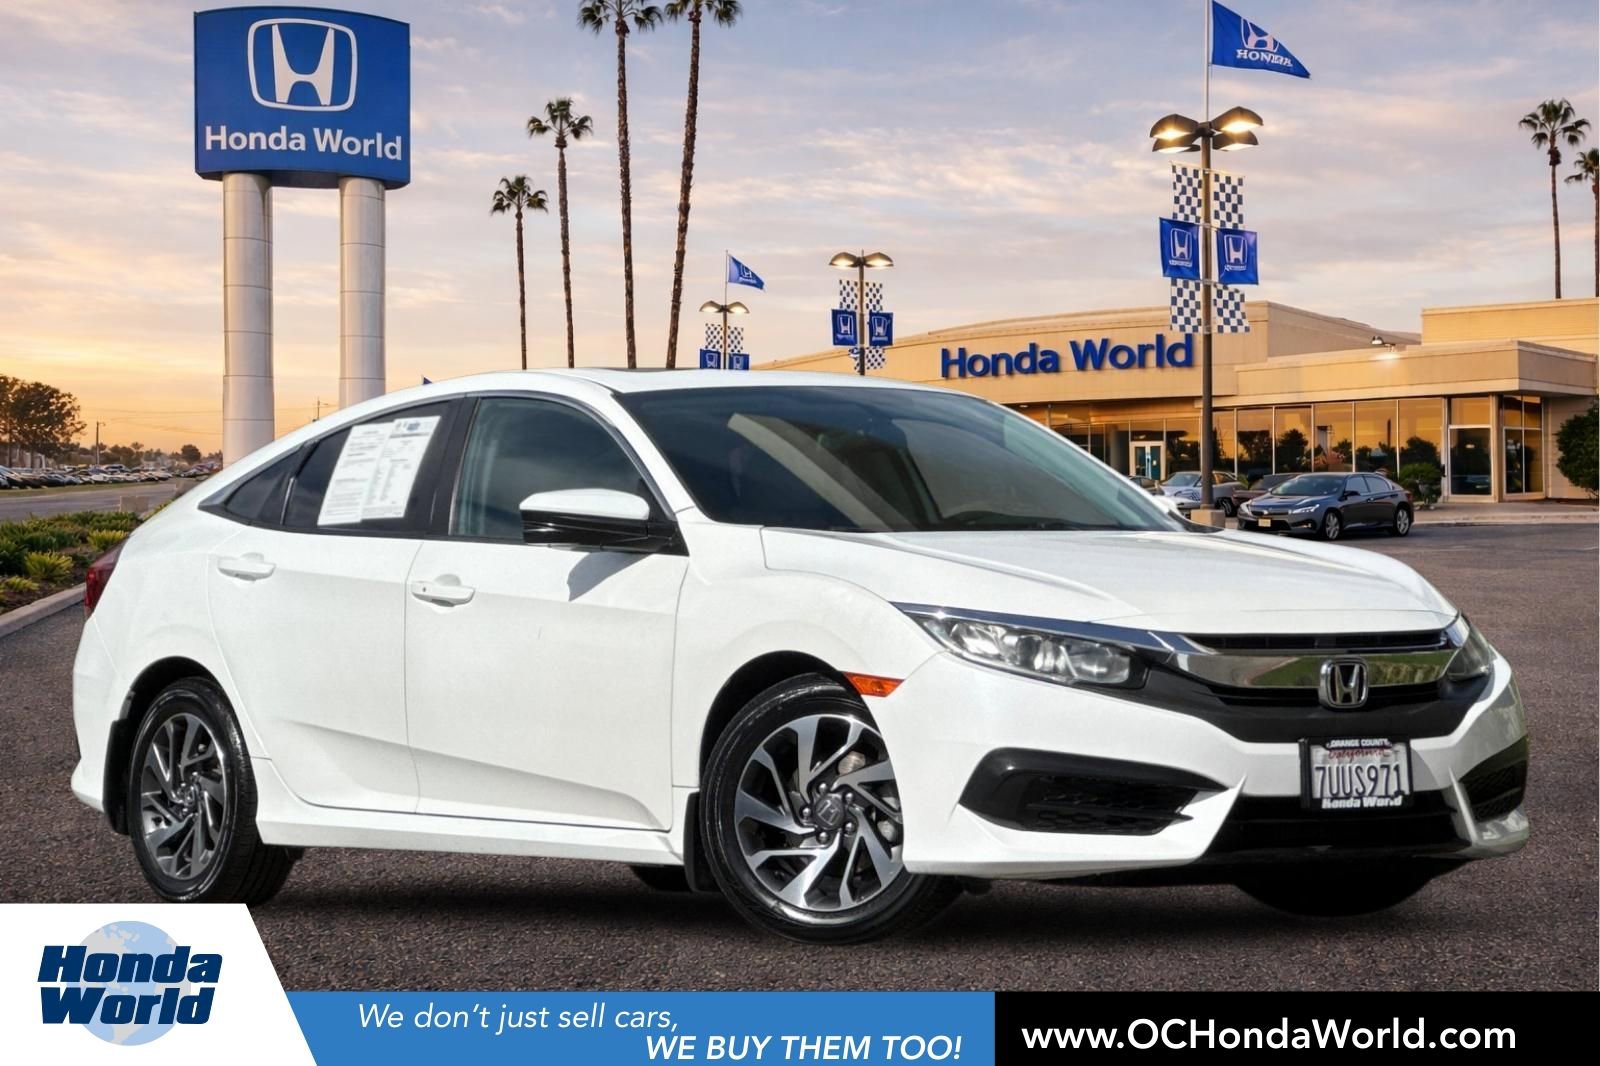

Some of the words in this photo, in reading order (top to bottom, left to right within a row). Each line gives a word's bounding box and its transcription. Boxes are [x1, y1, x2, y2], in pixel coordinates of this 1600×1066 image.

[205, 125, 306, 151] Honda
[313, 127, 402, 161] World
[941, 342, 1060, 378] Honda
[1069, 333, 1194, 370] World
[1329, 739, 1360, 748] ORANGE
[1360, 738, 1390, 747] COUNTY
[1314, 764, 1401, 798] 7UUS971
[1322, 796, 1361, 809] Honda
